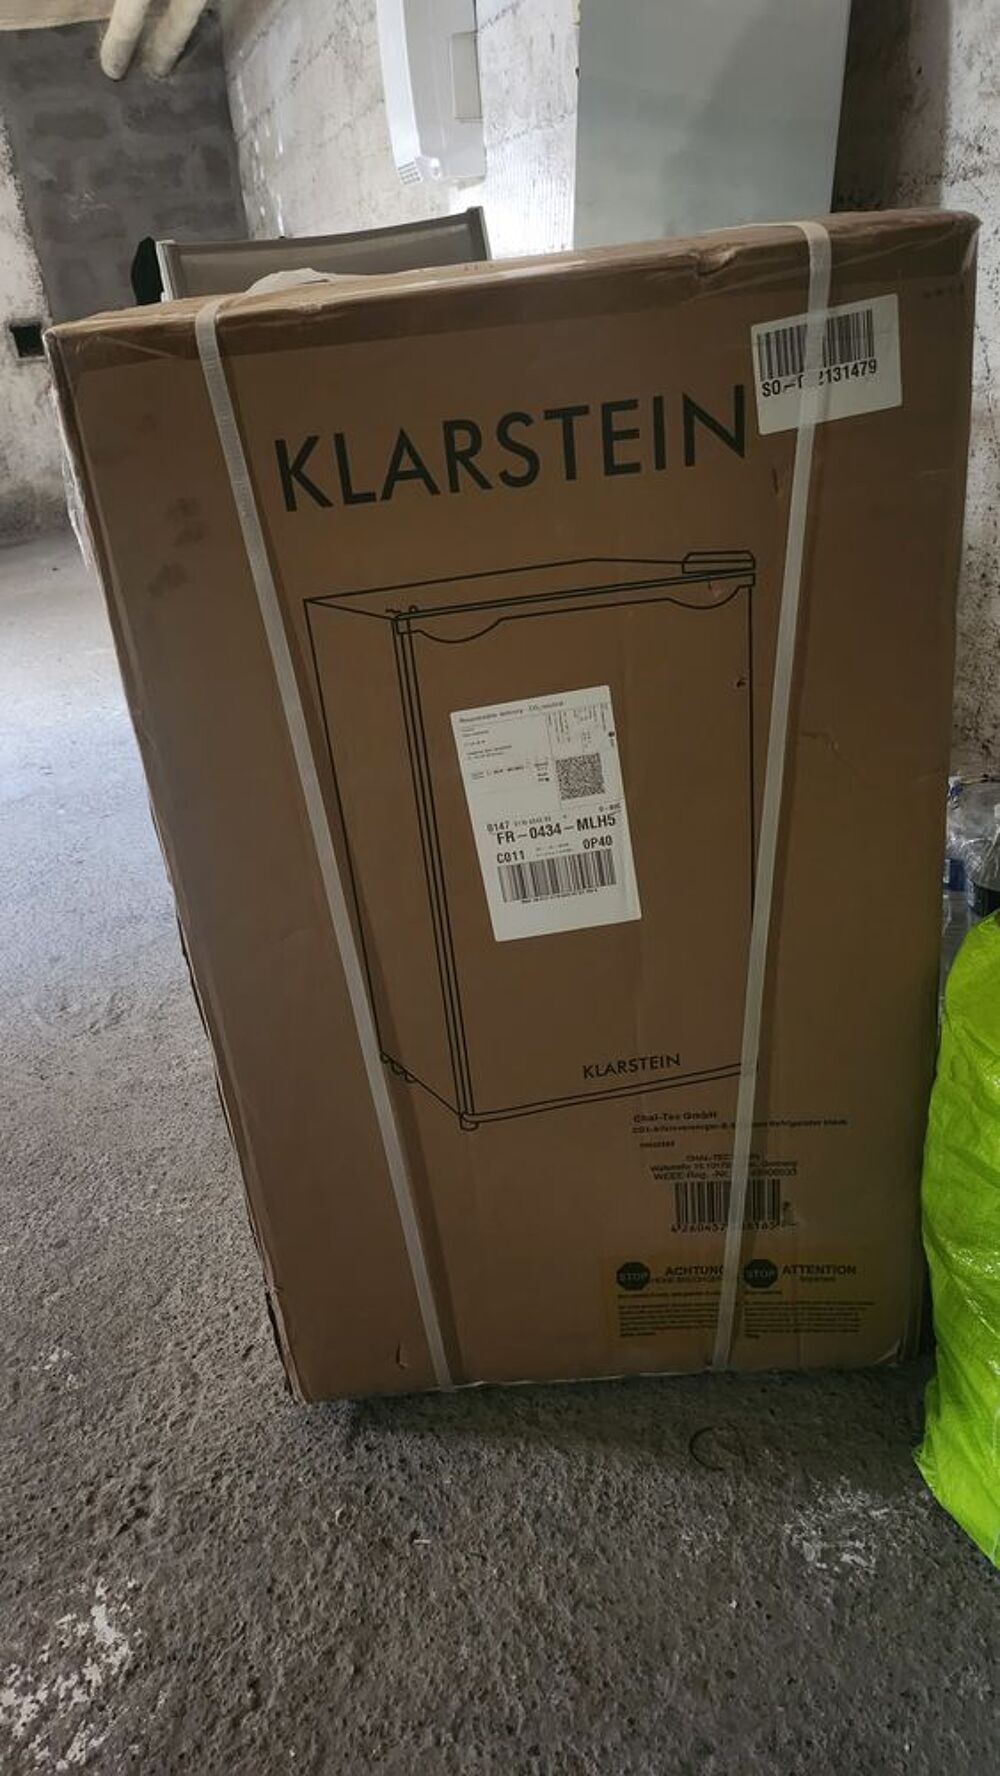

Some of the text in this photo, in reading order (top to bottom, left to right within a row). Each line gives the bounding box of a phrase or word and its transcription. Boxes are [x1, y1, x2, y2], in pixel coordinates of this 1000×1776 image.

[274, 384, 746, 512] KLARSTEIN
[582, 1053, 681, 1080] KLARSTEIN
[782, 1264, 857, 1276] ATTENTION
